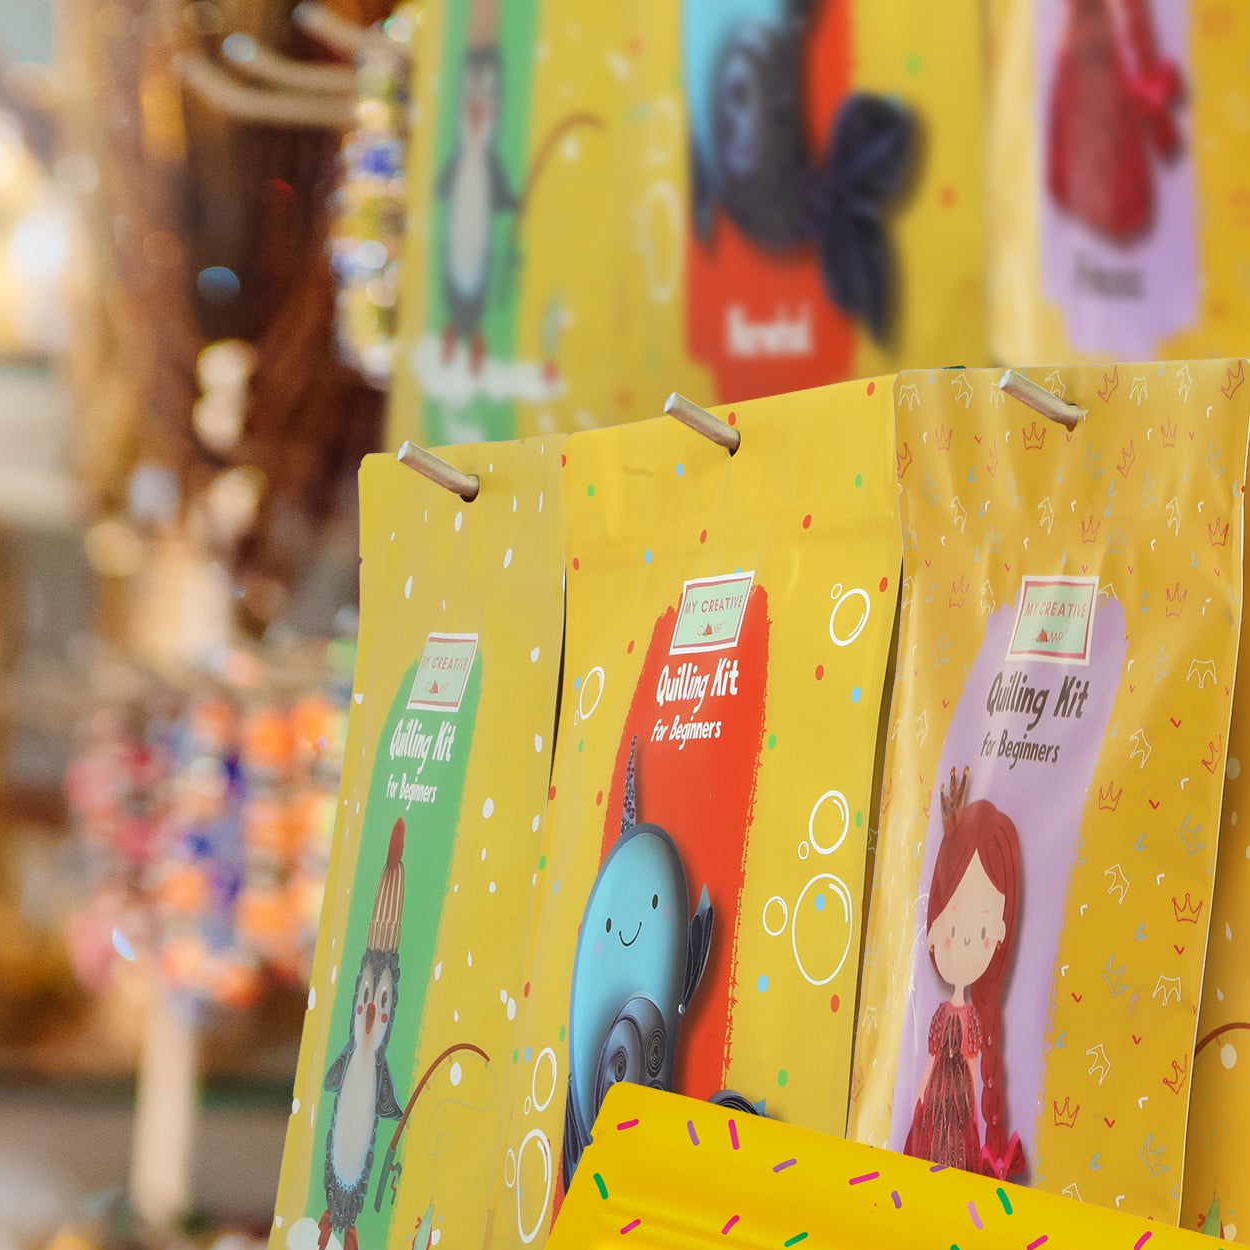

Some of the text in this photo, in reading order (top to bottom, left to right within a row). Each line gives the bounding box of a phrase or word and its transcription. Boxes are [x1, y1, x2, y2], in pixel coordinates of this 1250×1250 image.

[684, 595, 744, 614] MY CREATIVE
[1025, 602, 1086, 618] MY CREATIVE
[656, 657, 739, 714] Quilling Kit
[986, 671, 1090, 731] Quilling Kit
[389, 718, 456, 775] Quilling Kit
[651, 715, 722, 750] for Beginners
[980, 729, 1061, 770] for Beginners
[386, 772, 438, 811] for Beginners
